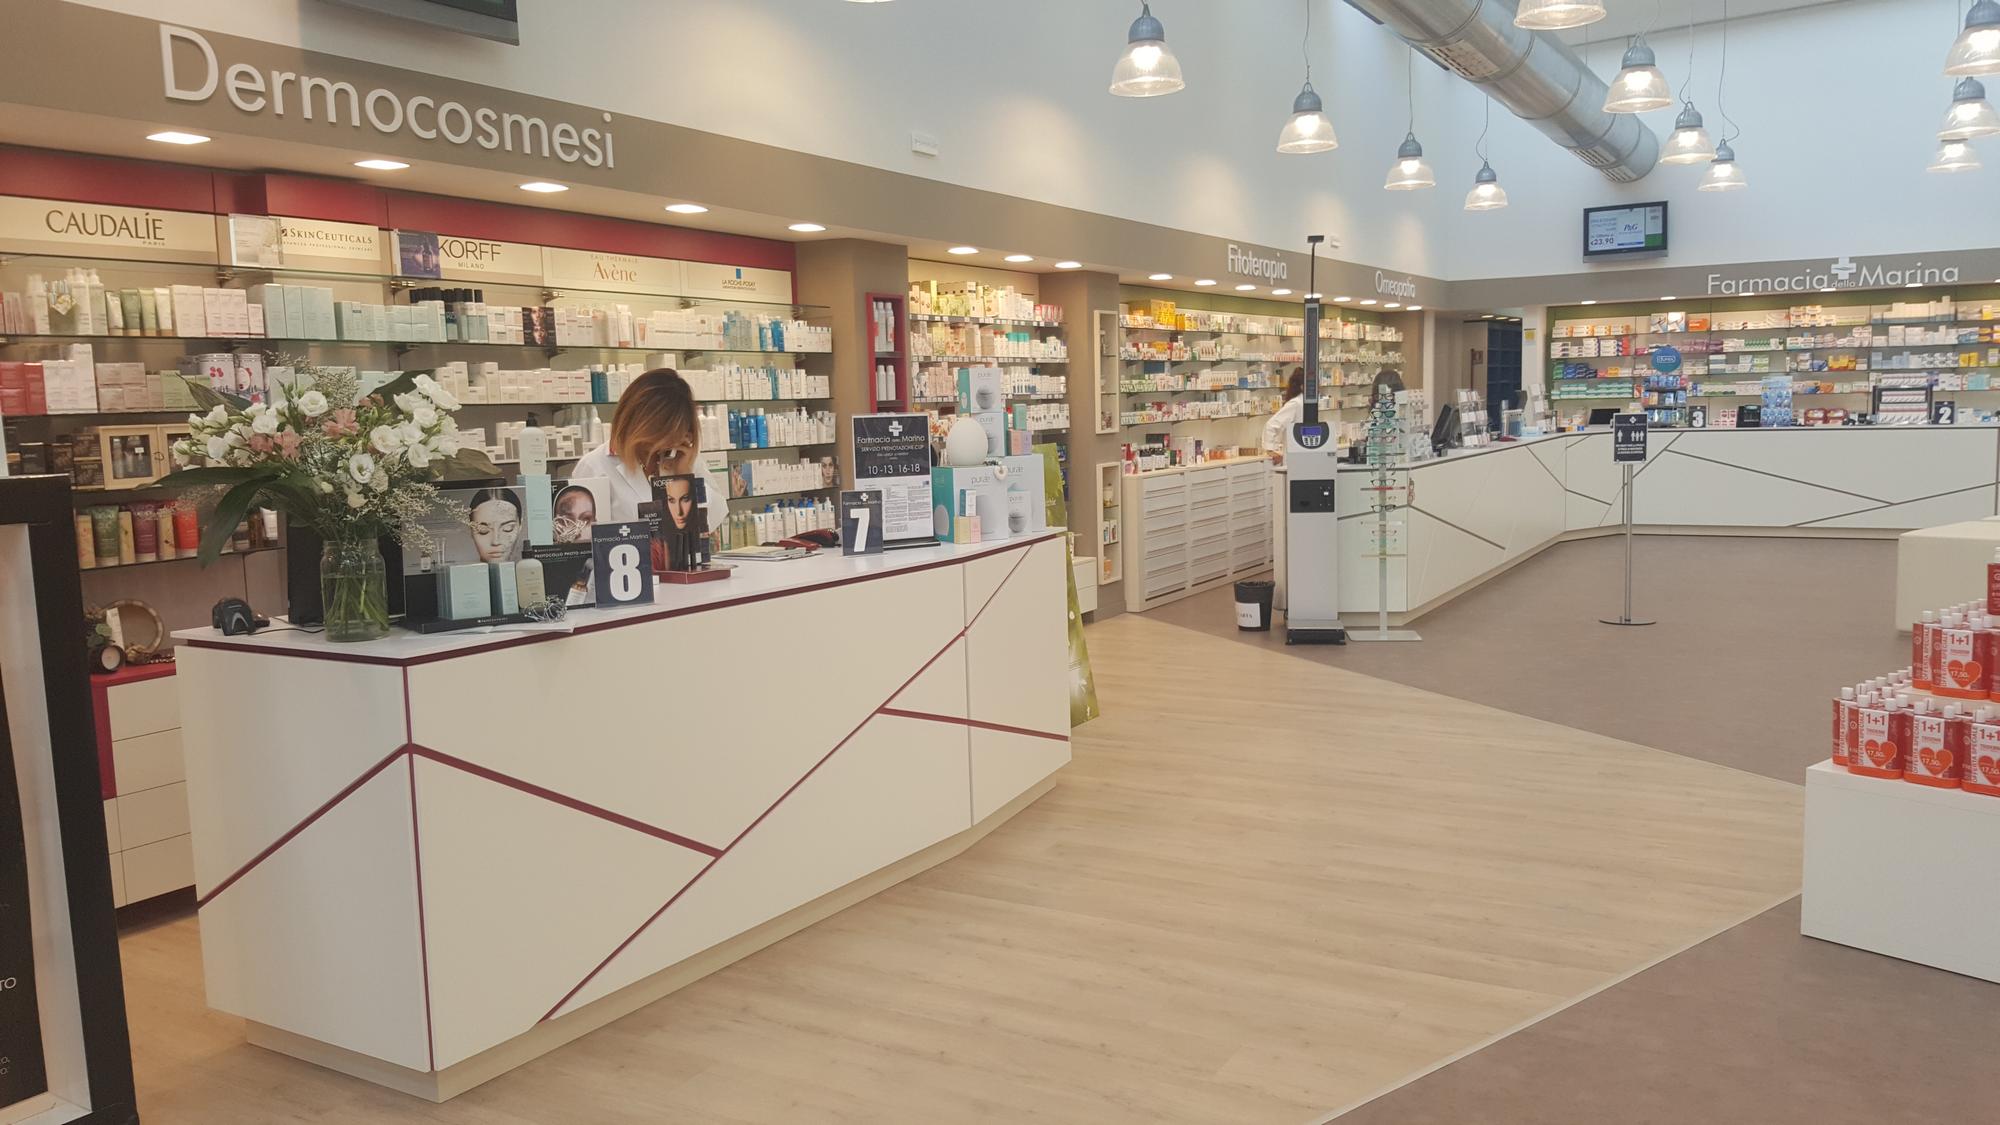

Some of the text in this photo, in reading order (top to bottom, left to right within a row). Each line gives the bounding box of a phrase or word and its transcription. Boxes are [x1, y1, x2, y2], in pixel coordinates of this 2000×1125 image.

[158, 23, 617, 168] Dermocosmesi
[438, 239, 502, 261] KORFF
[457, 261, 485, 270] MILANO
[593, 261, 637, 283] Avène
[1227, 244, 1288, 285] Fitoterapia
[1375, 269, 1416, 298] Omeopatia
[1707, 268, 1830, 295] Farmacia
[1858, 262, 1960, 287] Marina
[1692, 411, 1704, 428] 3
[1938, 407, 1952, 425] 2
[857, 435, 891, 444] Farmacia
[901, 433, 926, 442] Marina
[898, 463, 921, 473] 16-18
[629, 533, 649, 541] Marina
[849, 507, 870, 553] 7
[608, 543, 642, 602] 8
[1950, 634, 1969, 646] 1+1
[1866, 713, 1886, 726] 1+1
[1921, 720, 1941, 734] 1+1
[1979, 728, 2000, 742] 1+1
